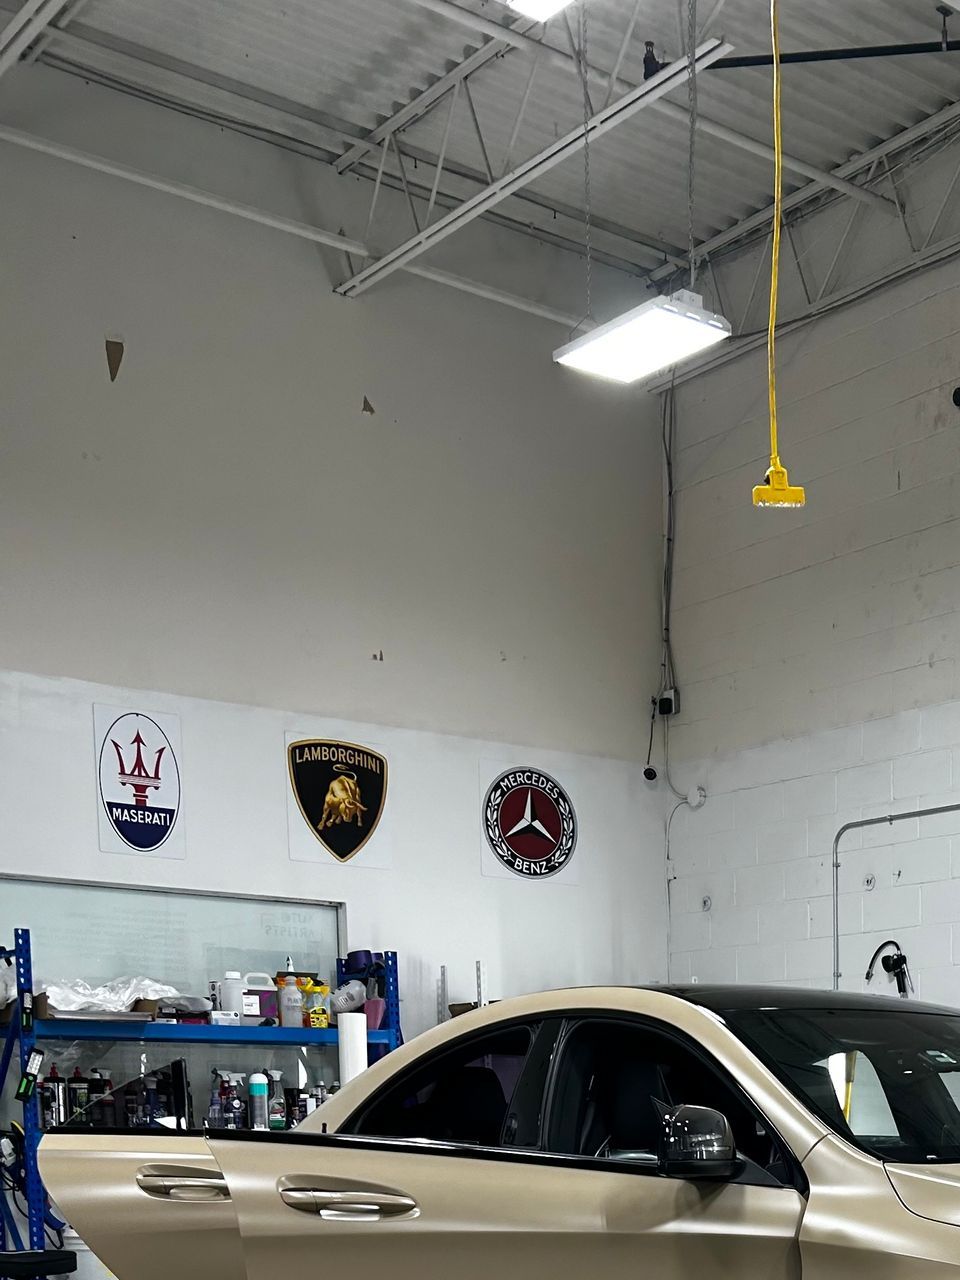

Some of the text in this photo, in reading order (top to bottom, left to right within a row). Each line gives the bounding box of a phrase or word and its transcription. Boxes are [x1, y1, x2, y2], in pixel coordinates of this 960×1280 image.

[295, 746, 381, 774] LAMBORGHINI
[499, 772, 560, 799] MERCEDES
[112, 807, 170, 827] MASERATI
[513, 857, 549, 874] BENZ
